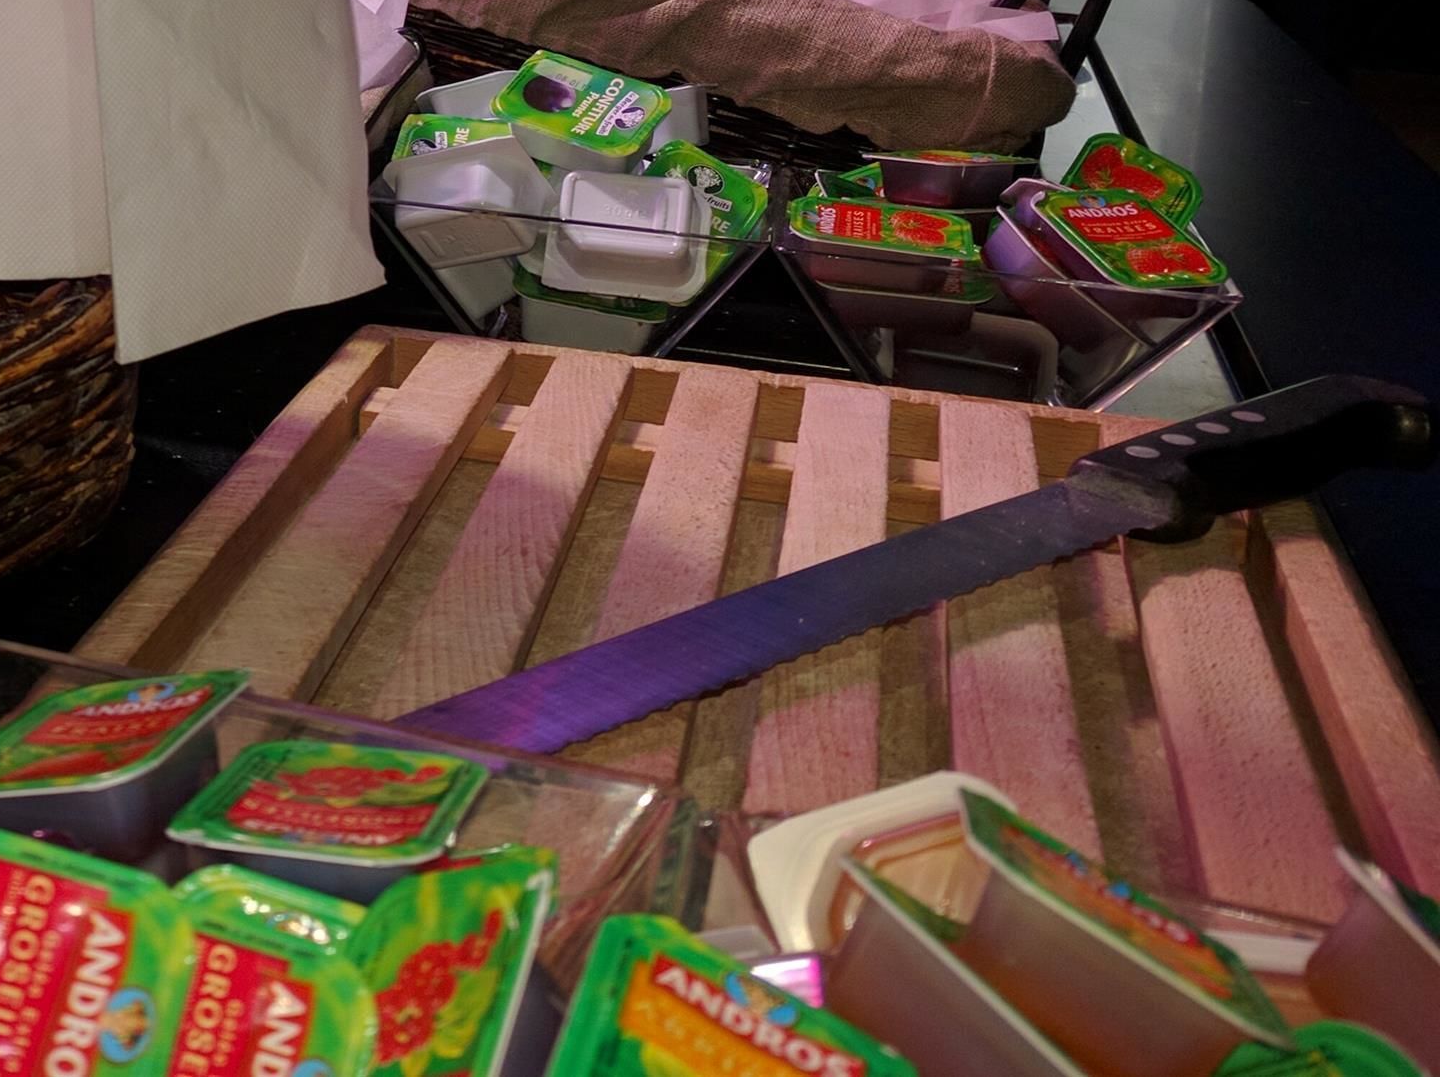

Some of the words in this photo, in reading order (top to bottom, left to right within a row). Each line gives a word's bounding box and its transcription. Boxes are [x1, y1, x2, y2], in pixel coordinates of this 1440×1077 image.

[571, 77, 624, 135] CONFITURE
[572, 91, 600, 117] Prunes
[707, 196, 730, 210] fruits
[1067, 203, 1139, 219] ANDROS
[819, 207, 836, 235] ANDROS
[1082, 222, 1157, 234] FRAISES
[72, 692, 202, 717] ANDROS
[655, 965, 853, 1077] ANDROS
